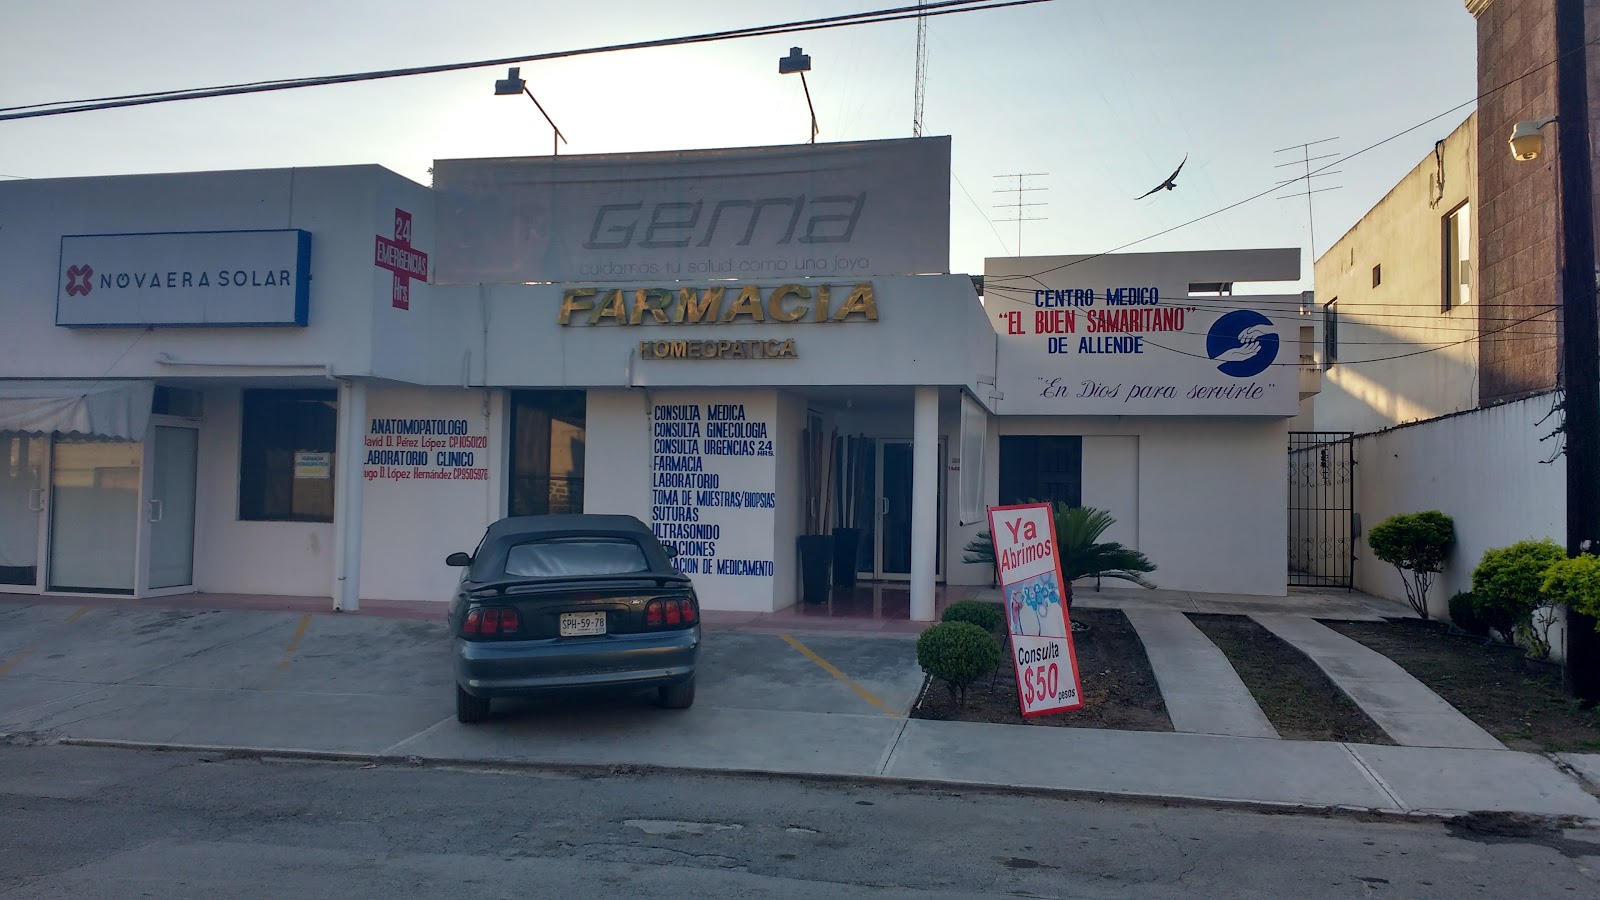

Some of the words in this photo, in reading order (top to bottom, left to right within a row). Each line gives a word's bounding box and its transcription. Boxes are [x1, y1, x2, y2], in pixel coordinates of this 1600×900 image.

[395, 217, 411, 242] 24
[377, 241, 427, 276] EMERGENCIAS
[579, 261, 658, 275] cuidamos
[666, 261, 681, 274] tu
[688, 259, 732, 274] salud
[739, 260, 788, 272] como
[795, 257, 827, 270] una
[832, 256, 869, 271] joya
[218, 270, 291, 287] SOLAR
[558, 281, 879, 326] FARMACIA
[1035, 288, 1094, 307] CENTRO
[1106, 287, 1159, 306] MEDICO
[1035, 310, 1076, 334] BUEN
[638, 338, 798, 359] HOMEOPATICA
[1048, 337, 1068, 354] DE
[1078, 336, 1144, 354] ALLENDE
[1076, 379, 1122, 399] Dios
[1125, 383, 1177, 402] para
[654, 405, 701, 421] CONSULTA
[707, 405, 746, 421] MEDICA
[371, 419, 468, 435] ANATOMOPATOLOGO
[654, 422, 700, 438] CONSULTA
[706, 422, 767, 439] GINECOLOGIA
[386, 435, 394, 447] D.
[396, 435, 419, 448] Pérez
[421, 435, 447, 451] López
[654, 439, 699, 455] CONSULTA
[704, 440, 755, 456] URGENCIAS
[758, 441, 773, 450] 24
[363, 450, 428, 466] ABORATORIO
[437, 451, 474, 467] CLINICO
[653, 456, 703, 472] FARMACIA
[364, 470, 378, 481] ugo
[387, 466, 411, 481] López
[413, 467, 452, 479] Hernández
[653, 473, 719, 489] LABORATORIO
[652, 490, 678, 506] TOMA
[682, 490, 692, 506] DE
[652, 507, 699, 522] SUTURAS
[652, 523, 720, 540] ULTRASONIDO
[1005, 517, 1037, 544] Ya
[1001, 539, 1051, 573] Abrimos
[702, 558, 712, 574] DE
[716, 558, 774, 577] MEDICAMENTO
[562, 617, 605, 629] SPH-59-78
[1018, 641, 1060, 666] Consulta
[1024, 662, 1059, 708] $50
[1058, 689, 1076, 703] pesos
